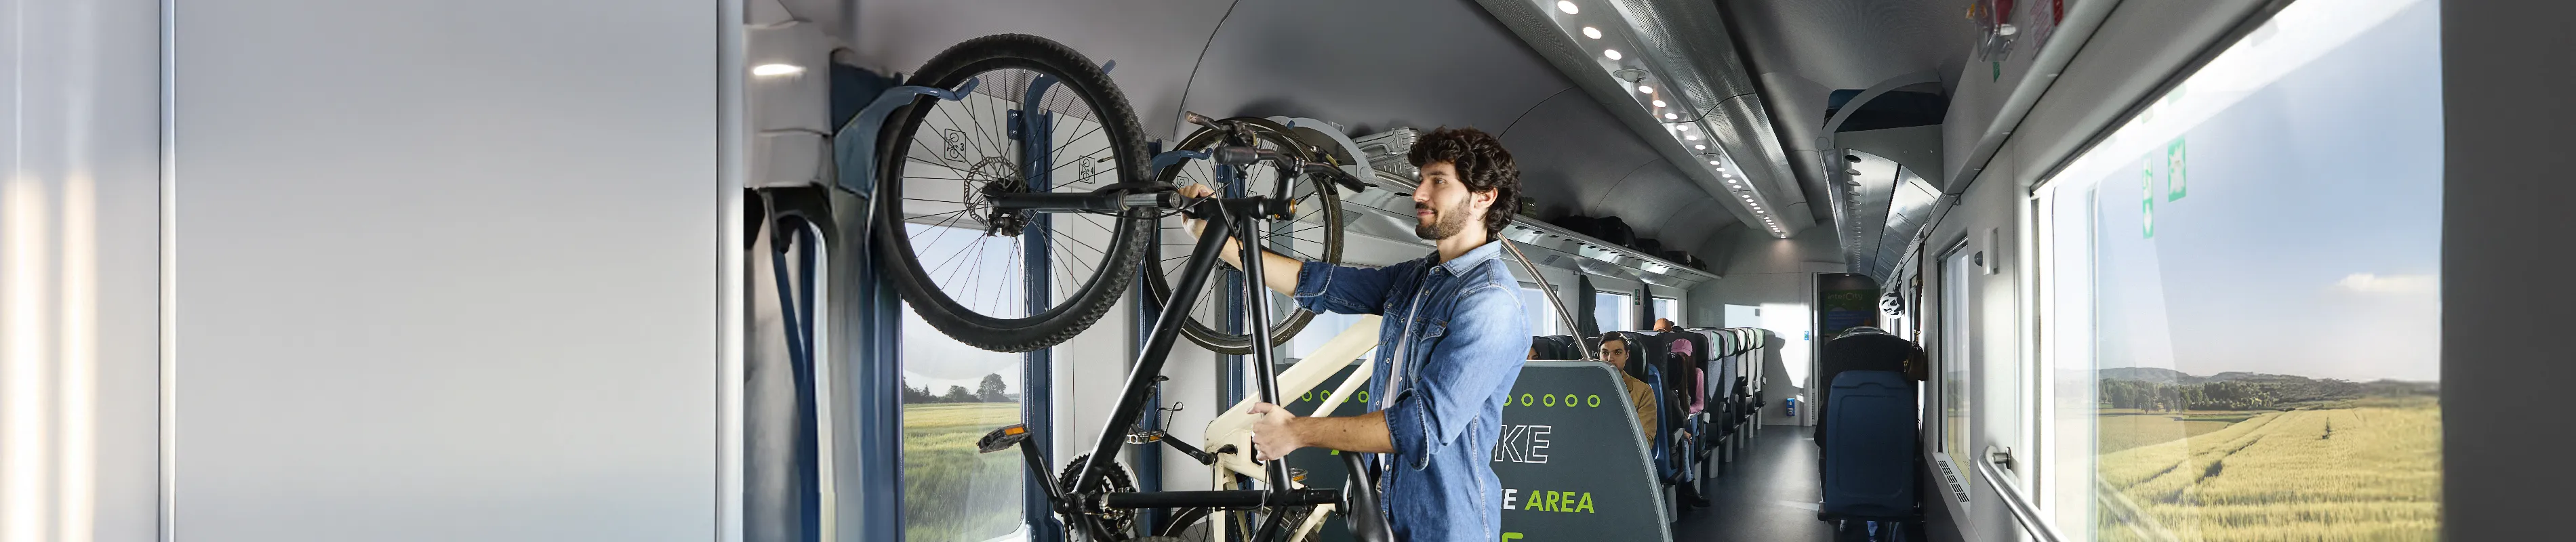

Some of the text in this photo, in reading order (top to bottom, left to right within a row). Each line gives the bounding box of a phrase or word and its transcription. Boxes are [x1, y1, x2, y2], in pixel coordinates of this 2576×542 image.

[960, 142, 964, 151] 3
[1494, 424, 1552, 463] KE
[1524, 490, 1595, 514] AREA
